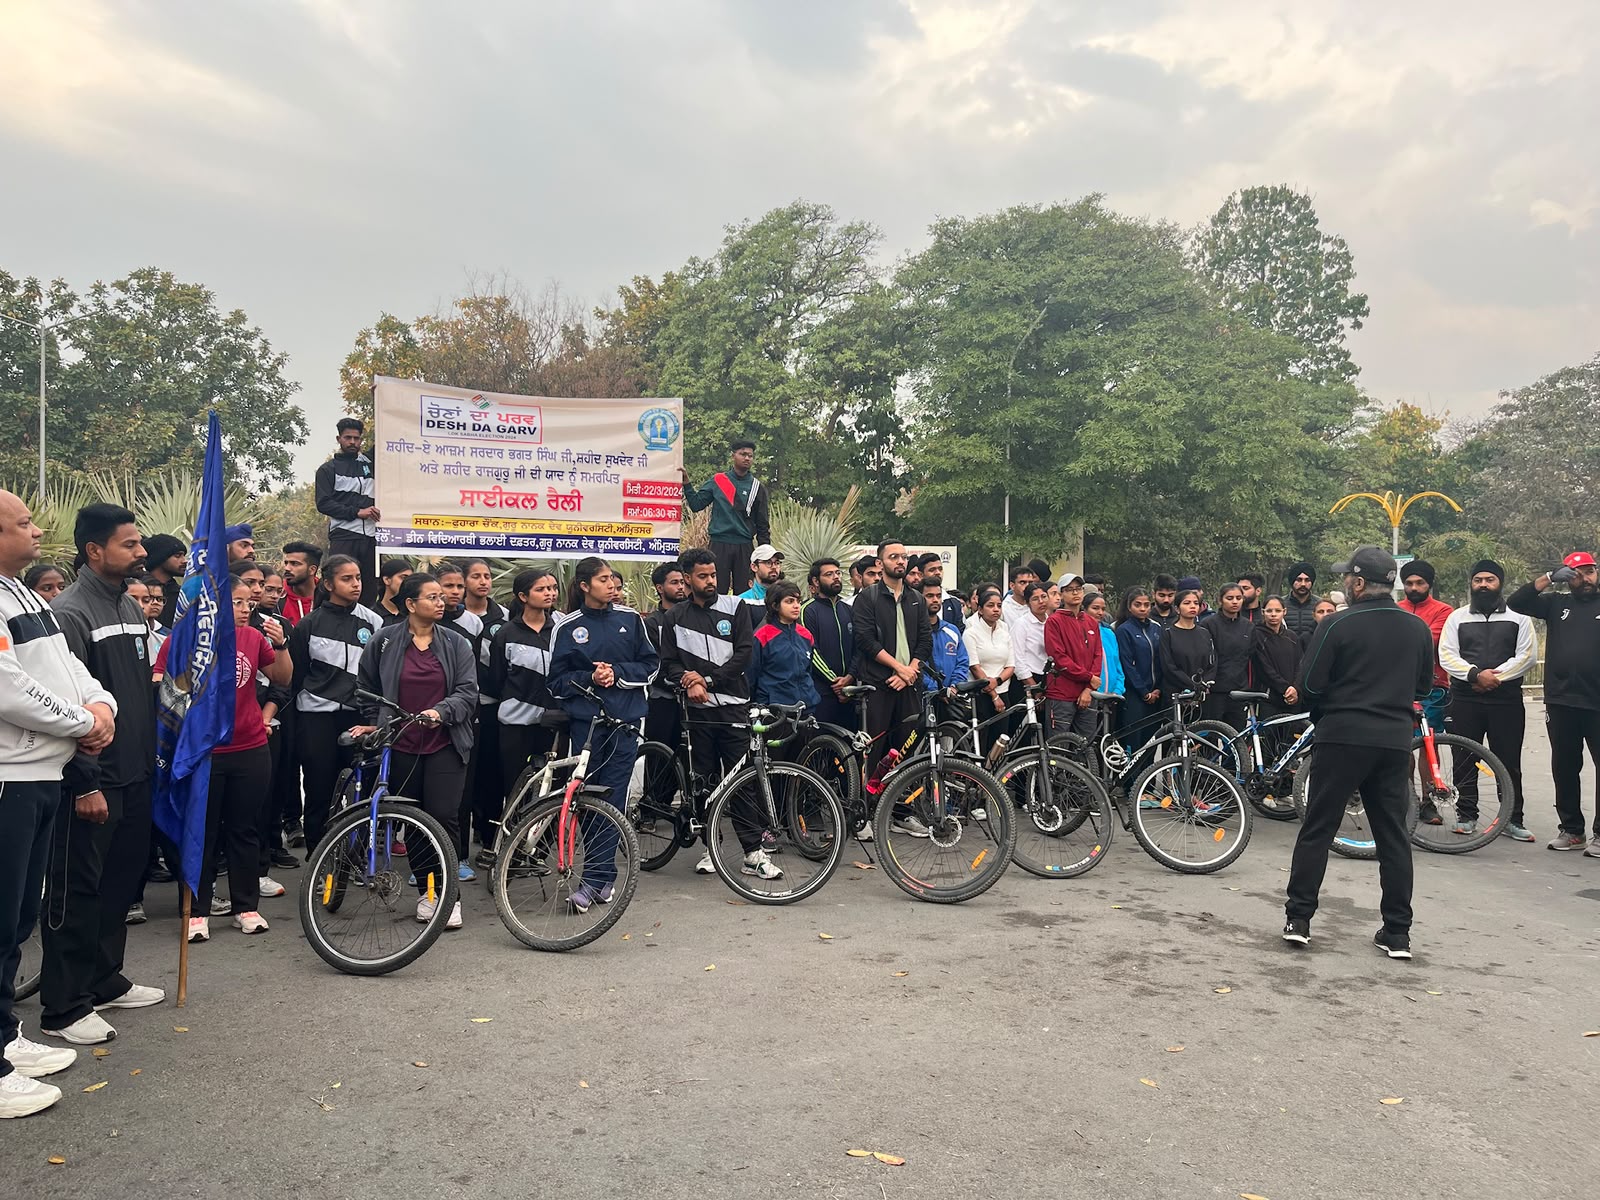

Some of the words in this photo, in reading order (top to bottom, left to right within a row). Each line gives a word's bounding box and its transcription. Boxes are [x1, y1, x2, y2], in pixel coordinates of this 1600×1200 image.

[428, 402, 462, 419] ਚੋਣਾਂ
[469, 410, 490, 421] ਦਾ
[497, 412, 535, 425] ਪਰਵ
[426, 419, 466, 431] DESH
[472, 423, 491, 433] DA
[496, 425, 537, 435] GARV
[386, 438, 431, 454] ਸ਼ਹੀਦ-ਏ
[470, 446, 504, 459] ਸਰਦਾਰ
[508, 449, 532, 460] ਭਗਤ
[537, 447, 557, 461] ਸਿੰਘ
[605, 451, 634, 468] ਸੁਖਦੇਵ
[637, 453, 648, 468] ਜੀ
[420, 460, 439, 474] ਅਤੇ
[443, 461, 471, 476] ਸ਼ਹੀਦ
[475, 465, 510, 483] ਰਾਜਗੁਰੂ
[514, 464, 526, 479] ਜੀ
[530, 465, 542, 480] ਦੀ
[545, 468, 565, 481] ਯਾਦ
[568, 467, 577, 487] ਨੂੰ
[580, 470, 620, 484] ਸਮਰਪਿਤ
[459, 485, 538, 510] ਸਾਈਕਲ
[546, 486, 583, 512] ਰੈਲੀ
[667, 507, 678, 519] ਵਜੇ
[520, 521, 545, 530] ਨਾਨਕ
[549, 521, 561, 531] ਦੇਵ
[406, 530, 424, 543] ਡੀਨ
[428, 531, 477, 545] ਵਿਦਿਆਰਥੀ
[480, 533, 506, 547] ਭਲਾਈ
[556, 538, 579, 548] ਨਾਨਕ
[581, 536, 595, 549] ਦੇਵ
[704, 752, 748, 810] MERIDA
